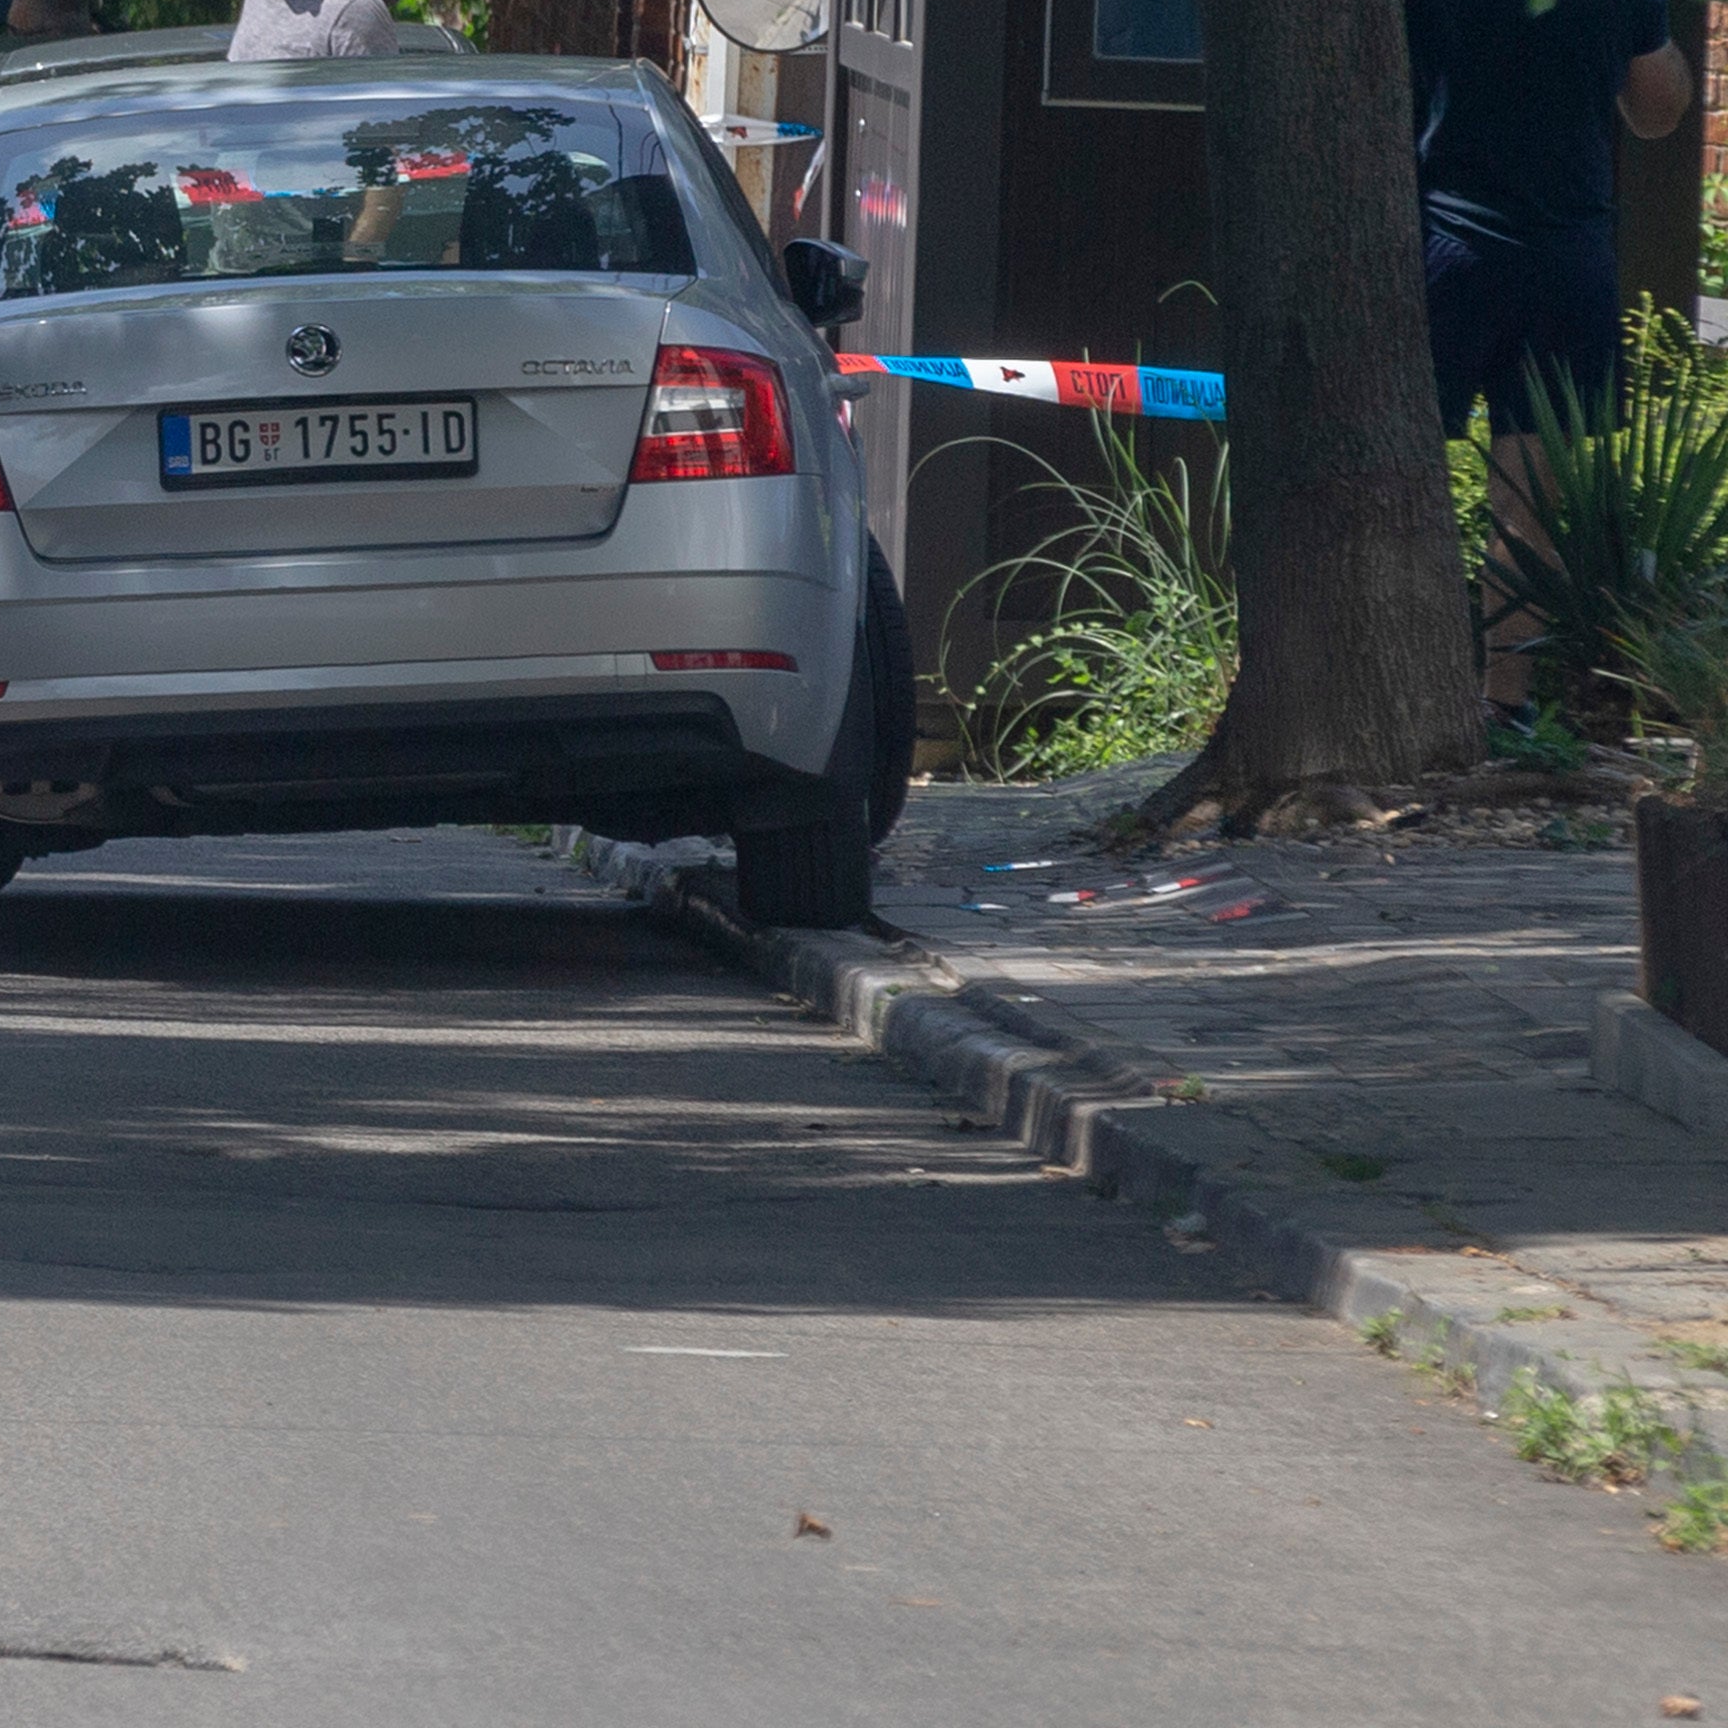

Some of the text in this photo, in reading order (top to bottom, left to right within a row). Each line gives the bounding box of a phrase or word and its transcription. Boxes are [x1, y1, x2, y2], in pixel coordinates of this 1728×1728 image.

[522, 359, 634, 375] OCTAVIA
[1071, 369, 1126, 399] СТОП
[199, 420, 251, 466] BG
[168, 455, 189, 469] SRB
